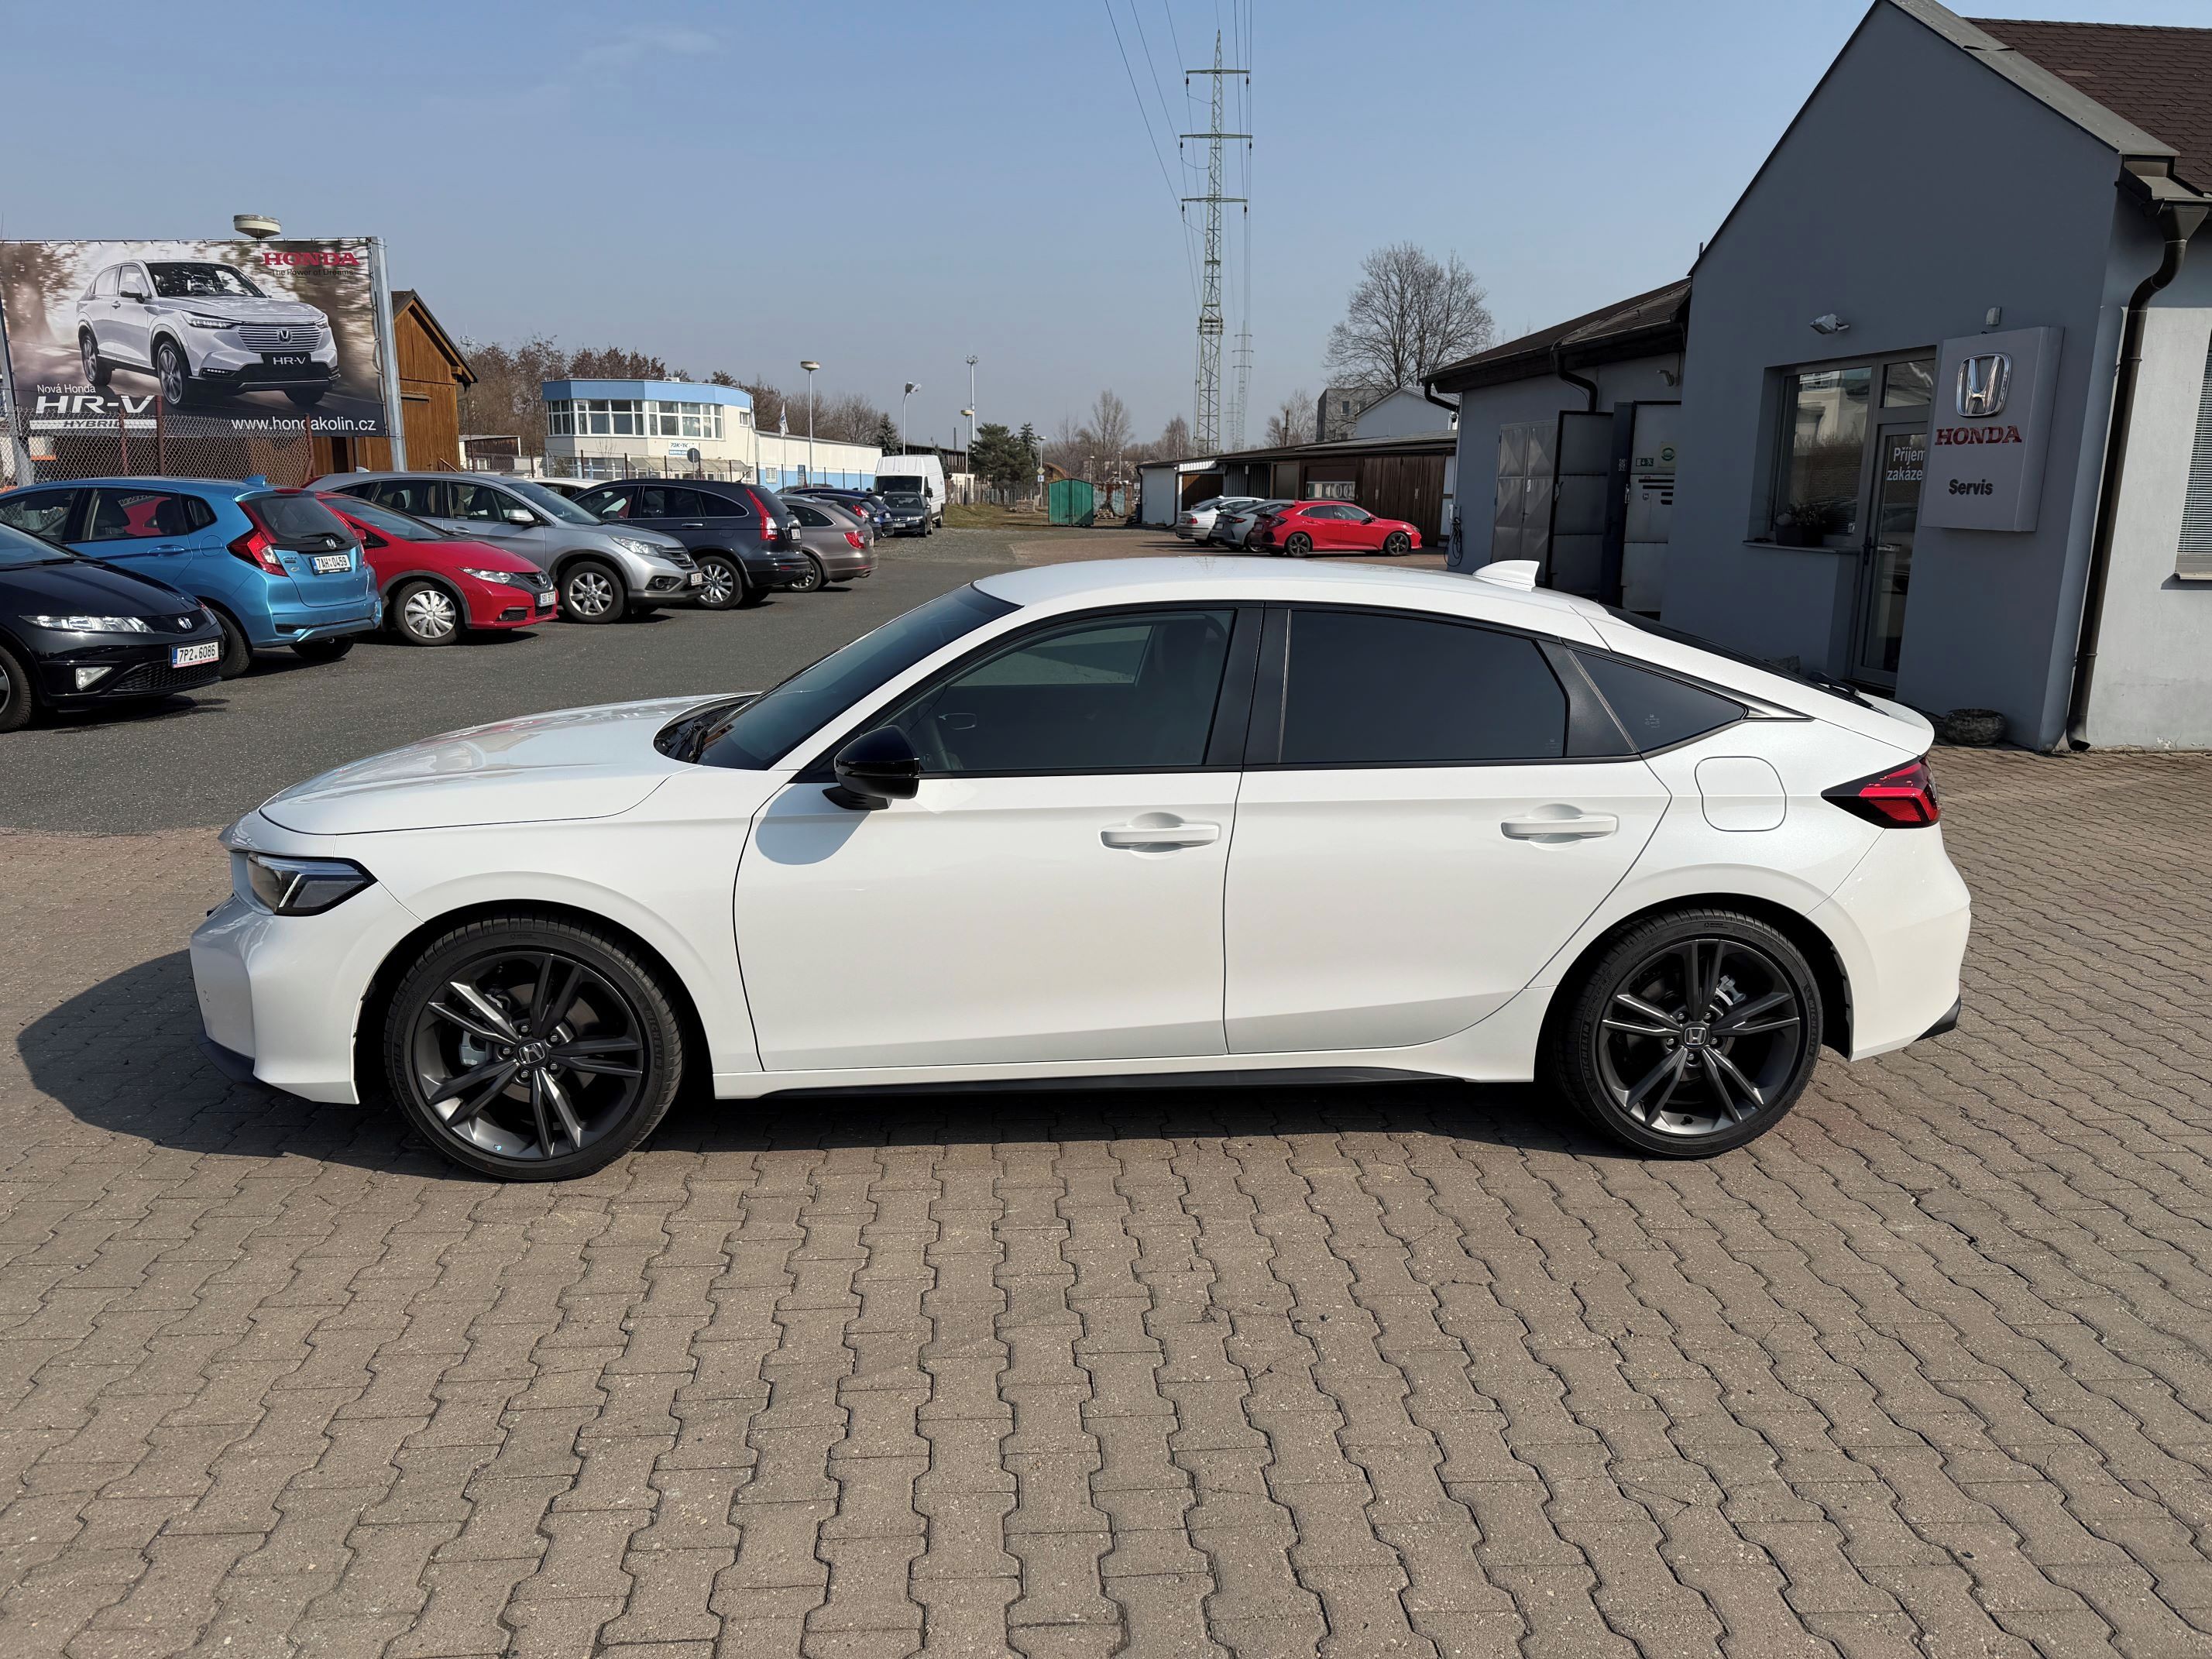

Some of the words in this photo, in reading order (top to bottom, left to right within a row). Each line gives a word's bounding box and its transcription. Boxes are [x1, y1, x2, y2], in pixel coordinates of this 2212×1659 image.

[263, 252, 359, 266] HONDA
[37, 383, 62, 394] Nová
[64, 384, 96, 393] Honda
[36, 395, 155, 414] HR-V
[1935, 425, 2022, 445] HONDA
[1949, 479, 1994, 496] Servis
[316, 558, 330, 568] 7AH
[332, 556, 348, 567] 0459
[179, 648, 194, 662] 7P2
[198, 644, 215, 659] 6086
[1808, 999, 1819, 1054] MICHELIN
[644, 1009, 662, 1066] MICHELIN
[1582, 1024, 1592, 1079] MICHELIN
